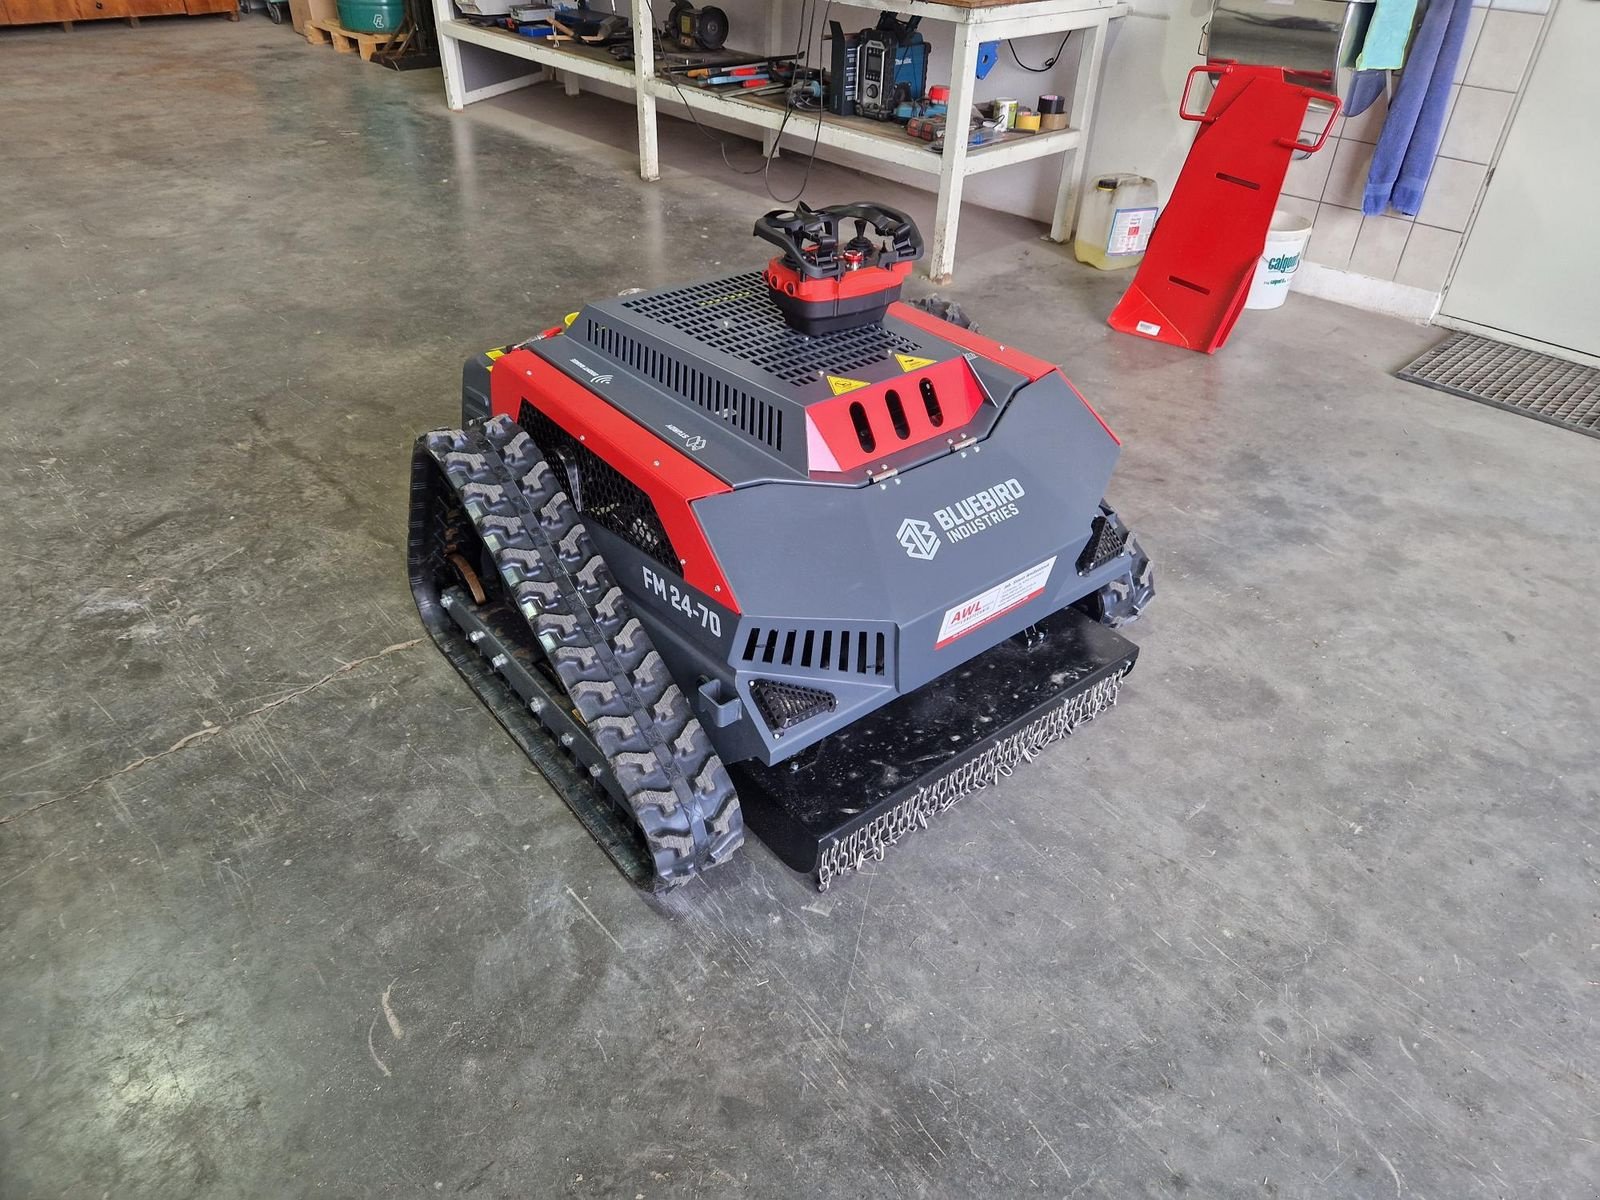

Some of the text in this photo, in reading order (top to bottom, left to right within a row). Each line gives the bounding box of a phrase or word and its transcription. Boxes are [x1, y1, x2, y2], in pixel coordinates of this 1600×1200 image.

[933, 478, 1026, 531] BLUEBIRD
[946, 503, 1020, 544] INDUSTRIES
[642, 566, 721, 638] FM 24-70
[951, 601, 982, 625] AWL
